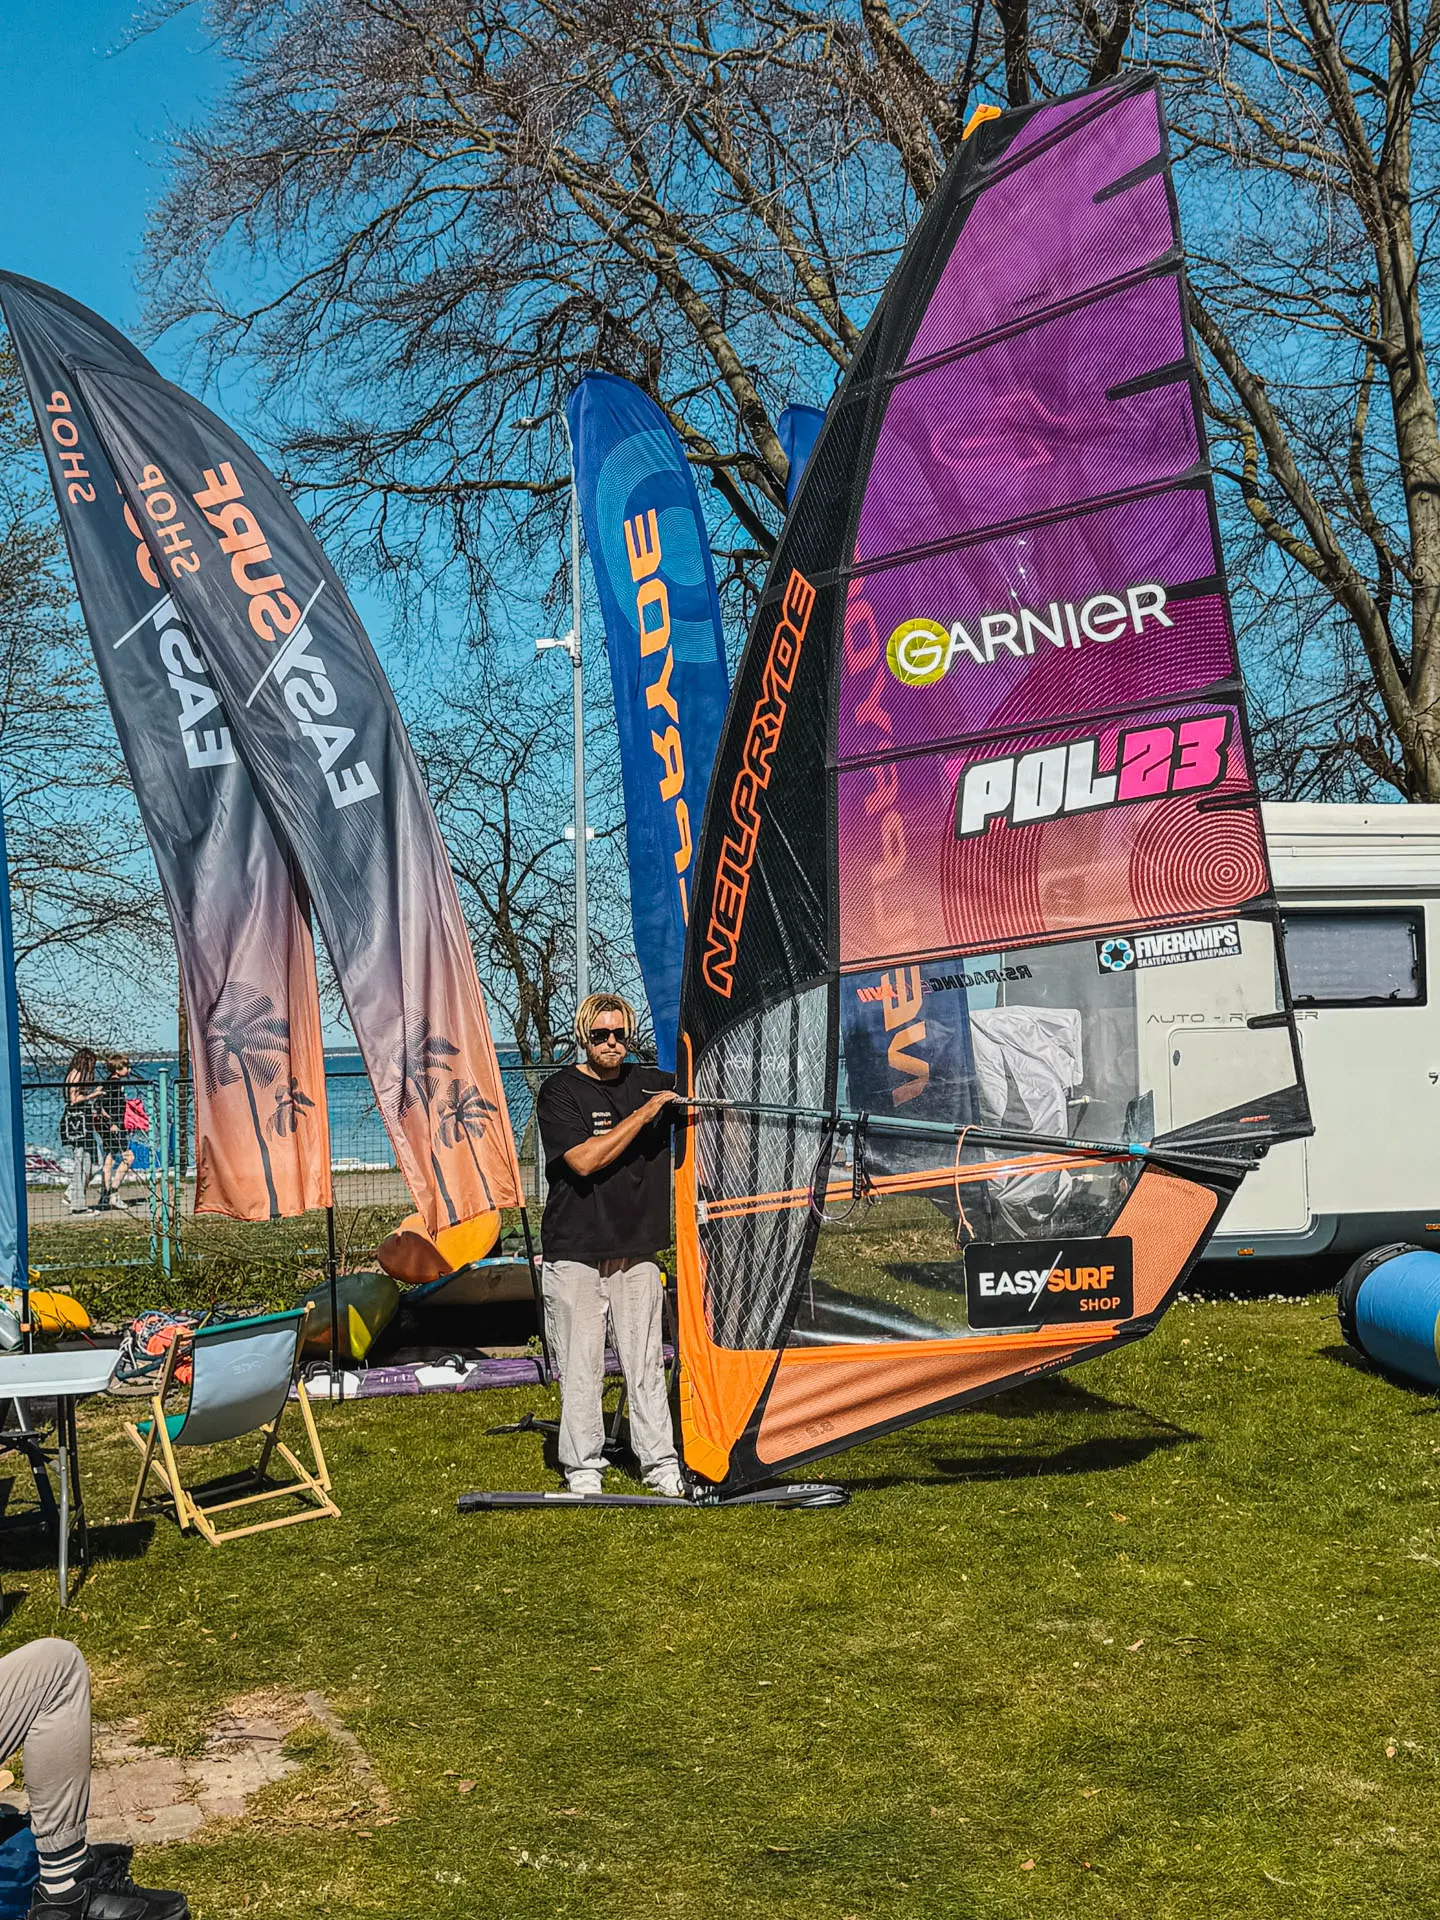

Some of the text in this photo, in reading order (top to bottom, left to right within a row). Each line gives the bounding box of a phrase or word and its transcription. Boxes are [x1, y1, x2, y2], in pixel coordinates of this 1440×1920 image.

[702, 567, 818, 999] NEILPRYDE
[1134, 924, 1238, 959] FIVERAMPS
[1137, 952, 1187, 968] SKATEPARKS
[1196, 945, 1240, 962] BIKEPARKS
[1146, 1013, 1205, 1024] AUTO
[1079, 1296, 1121, 1312] SHOP
